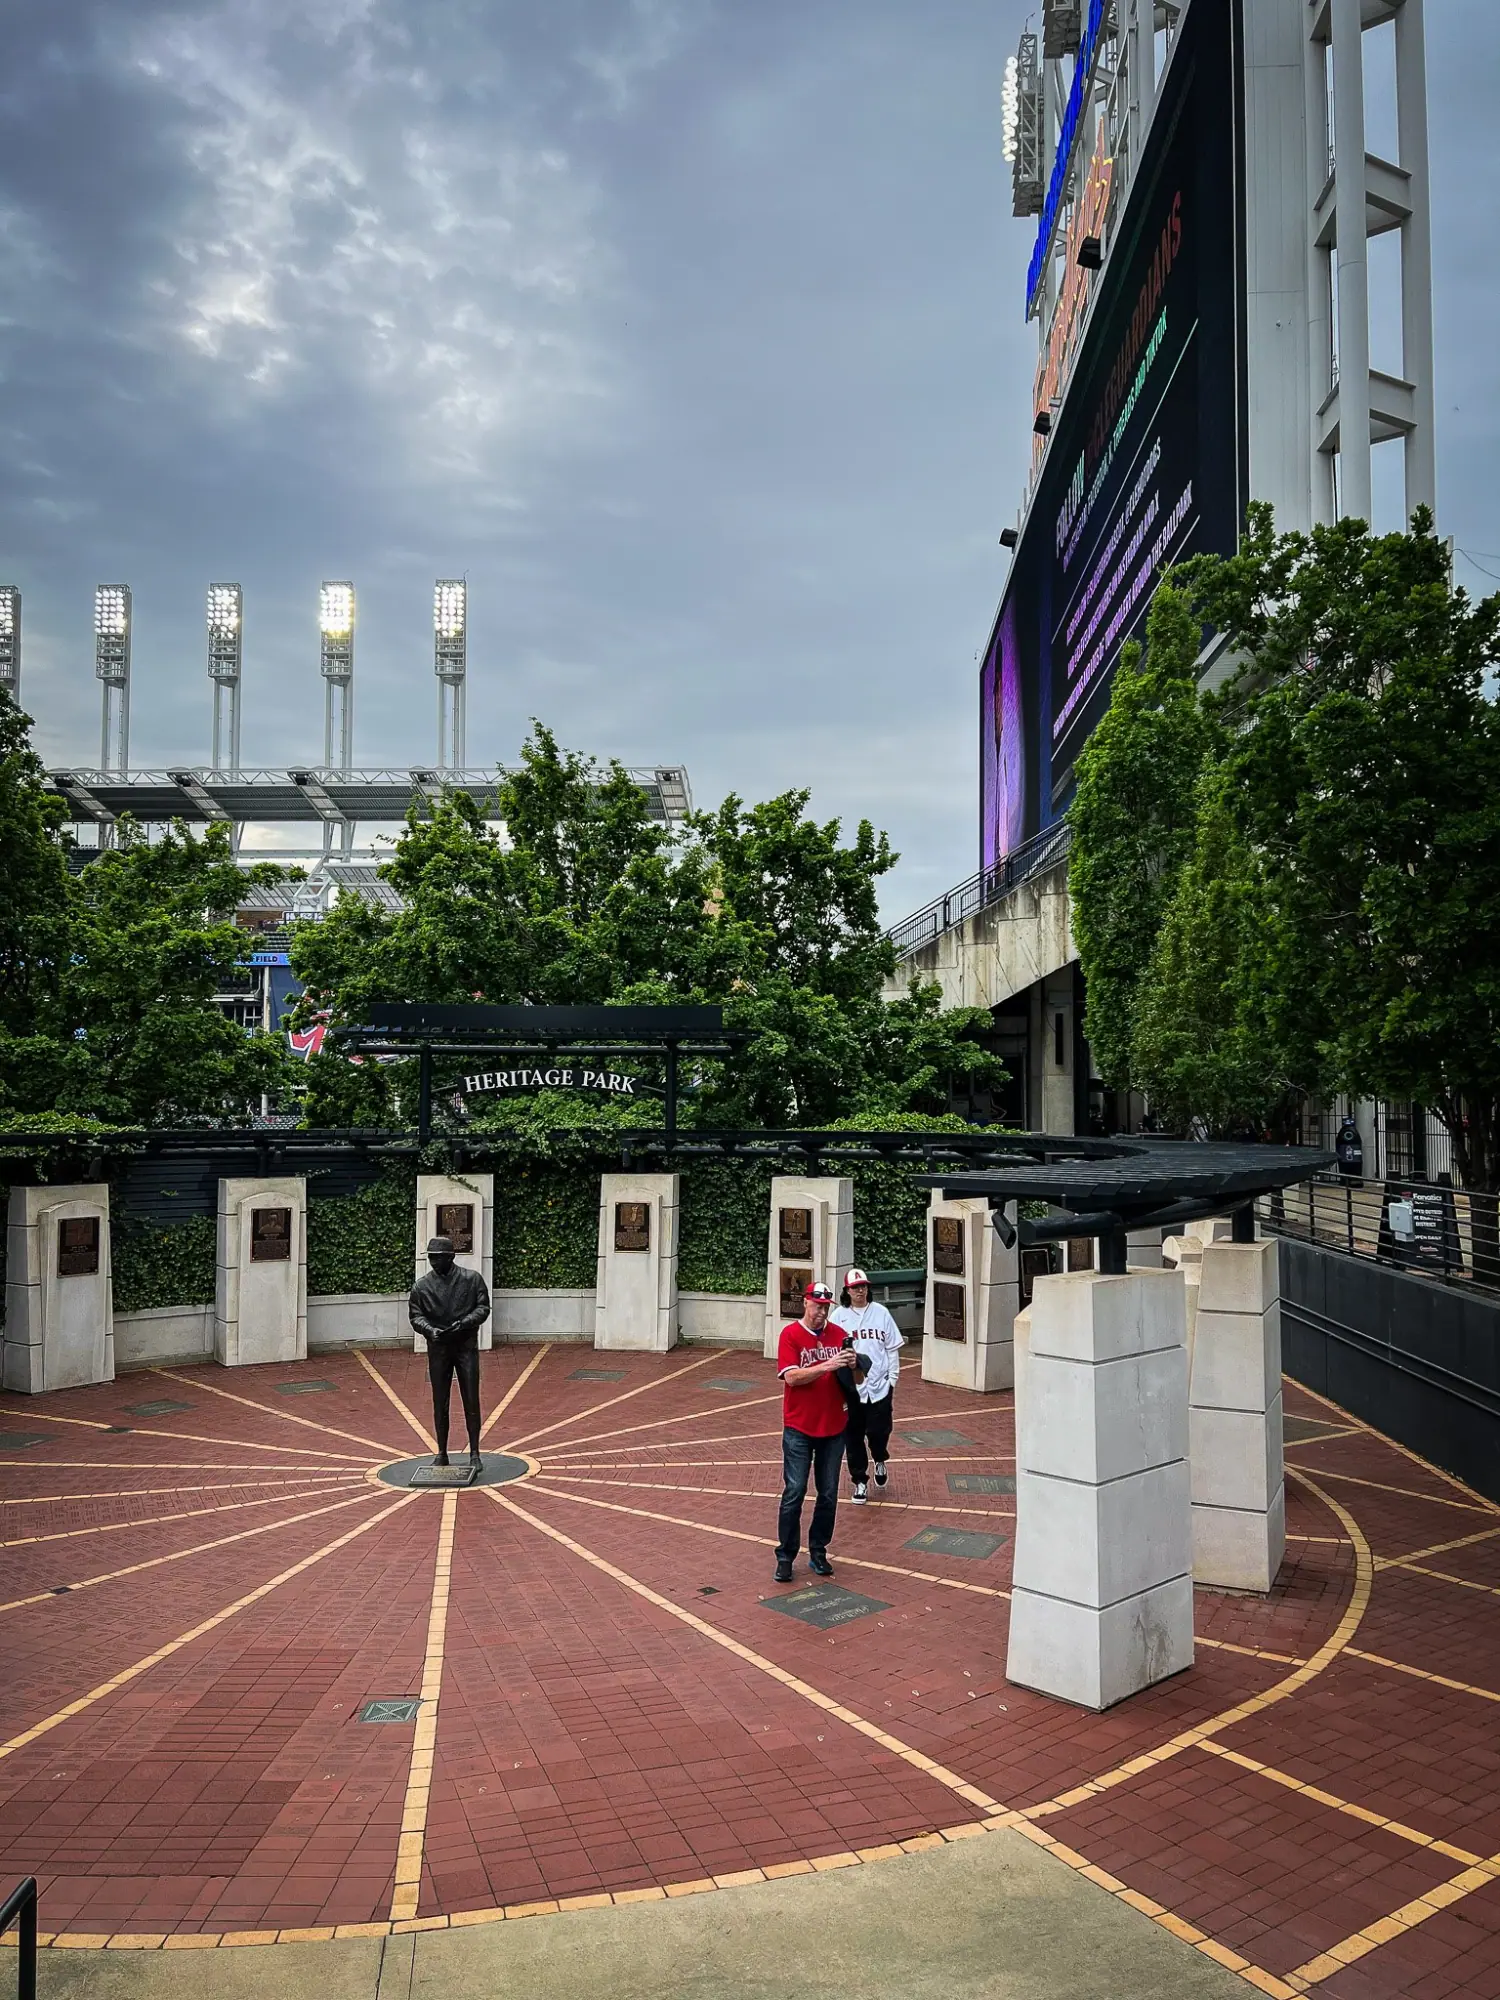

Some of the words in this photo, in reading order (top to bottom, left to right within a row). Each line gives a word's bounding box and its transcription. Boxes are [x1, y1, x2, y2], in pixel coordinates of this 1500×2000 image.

[1056, 446, 1084, 563] FOLLOW
[1152, 530, 1161, 571] THE
[1163, 477, 1191, 552] BALLPARK
[464, 1068, 574, 1092] HERITAGE
[581, 1070, 637, 1094] PARK
[855, 1271, 861, 1279] A
[850, 1328, 886, 1343] NGELS
[801, 1345, 842, 1368] ANGEL
